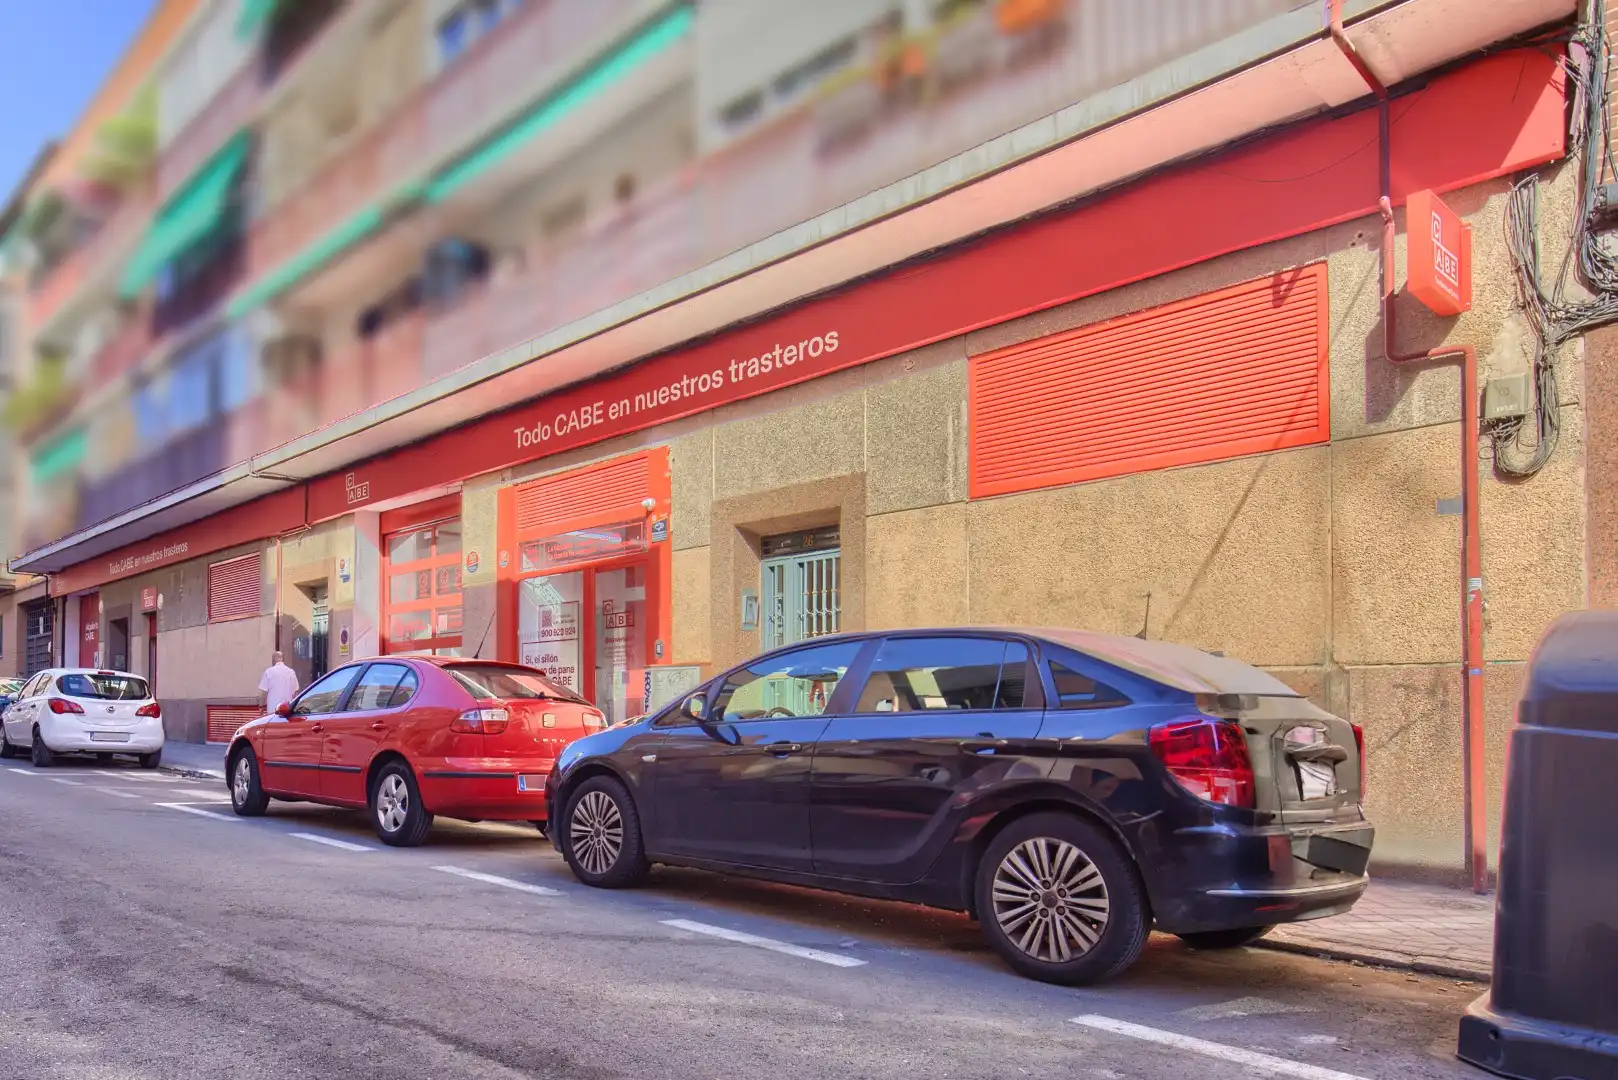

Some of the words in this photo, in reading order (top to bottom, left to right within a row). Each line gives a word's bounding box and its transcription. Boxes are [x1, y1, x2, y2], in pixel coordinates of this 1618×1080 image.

[514, 421, 551, 448] Todo
[554, 401, 604, 436] CABE
[608, 398, 630, 420] en
[635, 369, 724, 412] nuestros
[728, 331, 839, 383] trasteros
[109, 563, 120, 575] Todo
[120, 556, 134, 573] CABE
[134, 559, 141, 567] en
[141, 550, 163, 564] nuestros
[163, 542, 188, 557] trasteros
[541, 629, 552, 638] 900
[548, 665, 557, 675] de
[558, 666, 575, 676] pana
